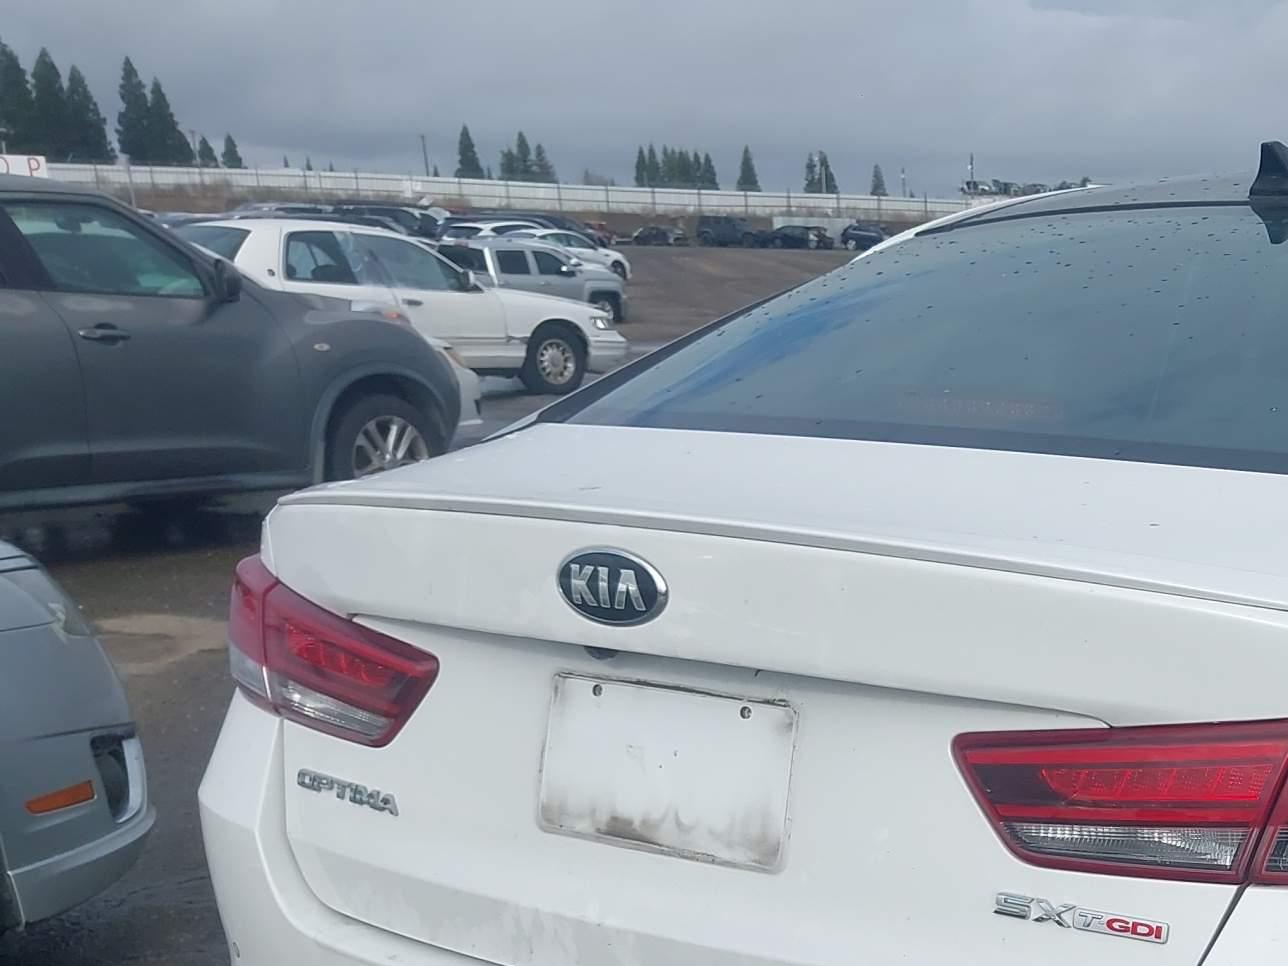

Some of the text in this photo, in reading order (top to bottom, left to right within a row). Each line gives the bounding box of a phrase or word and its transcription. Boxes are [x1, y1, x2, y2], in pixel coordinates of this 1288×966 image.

[570, 563, 646, 611] KIA
[297, 768, 399, 816] OPTIMA
[992, 892, 1076, 928] SX
